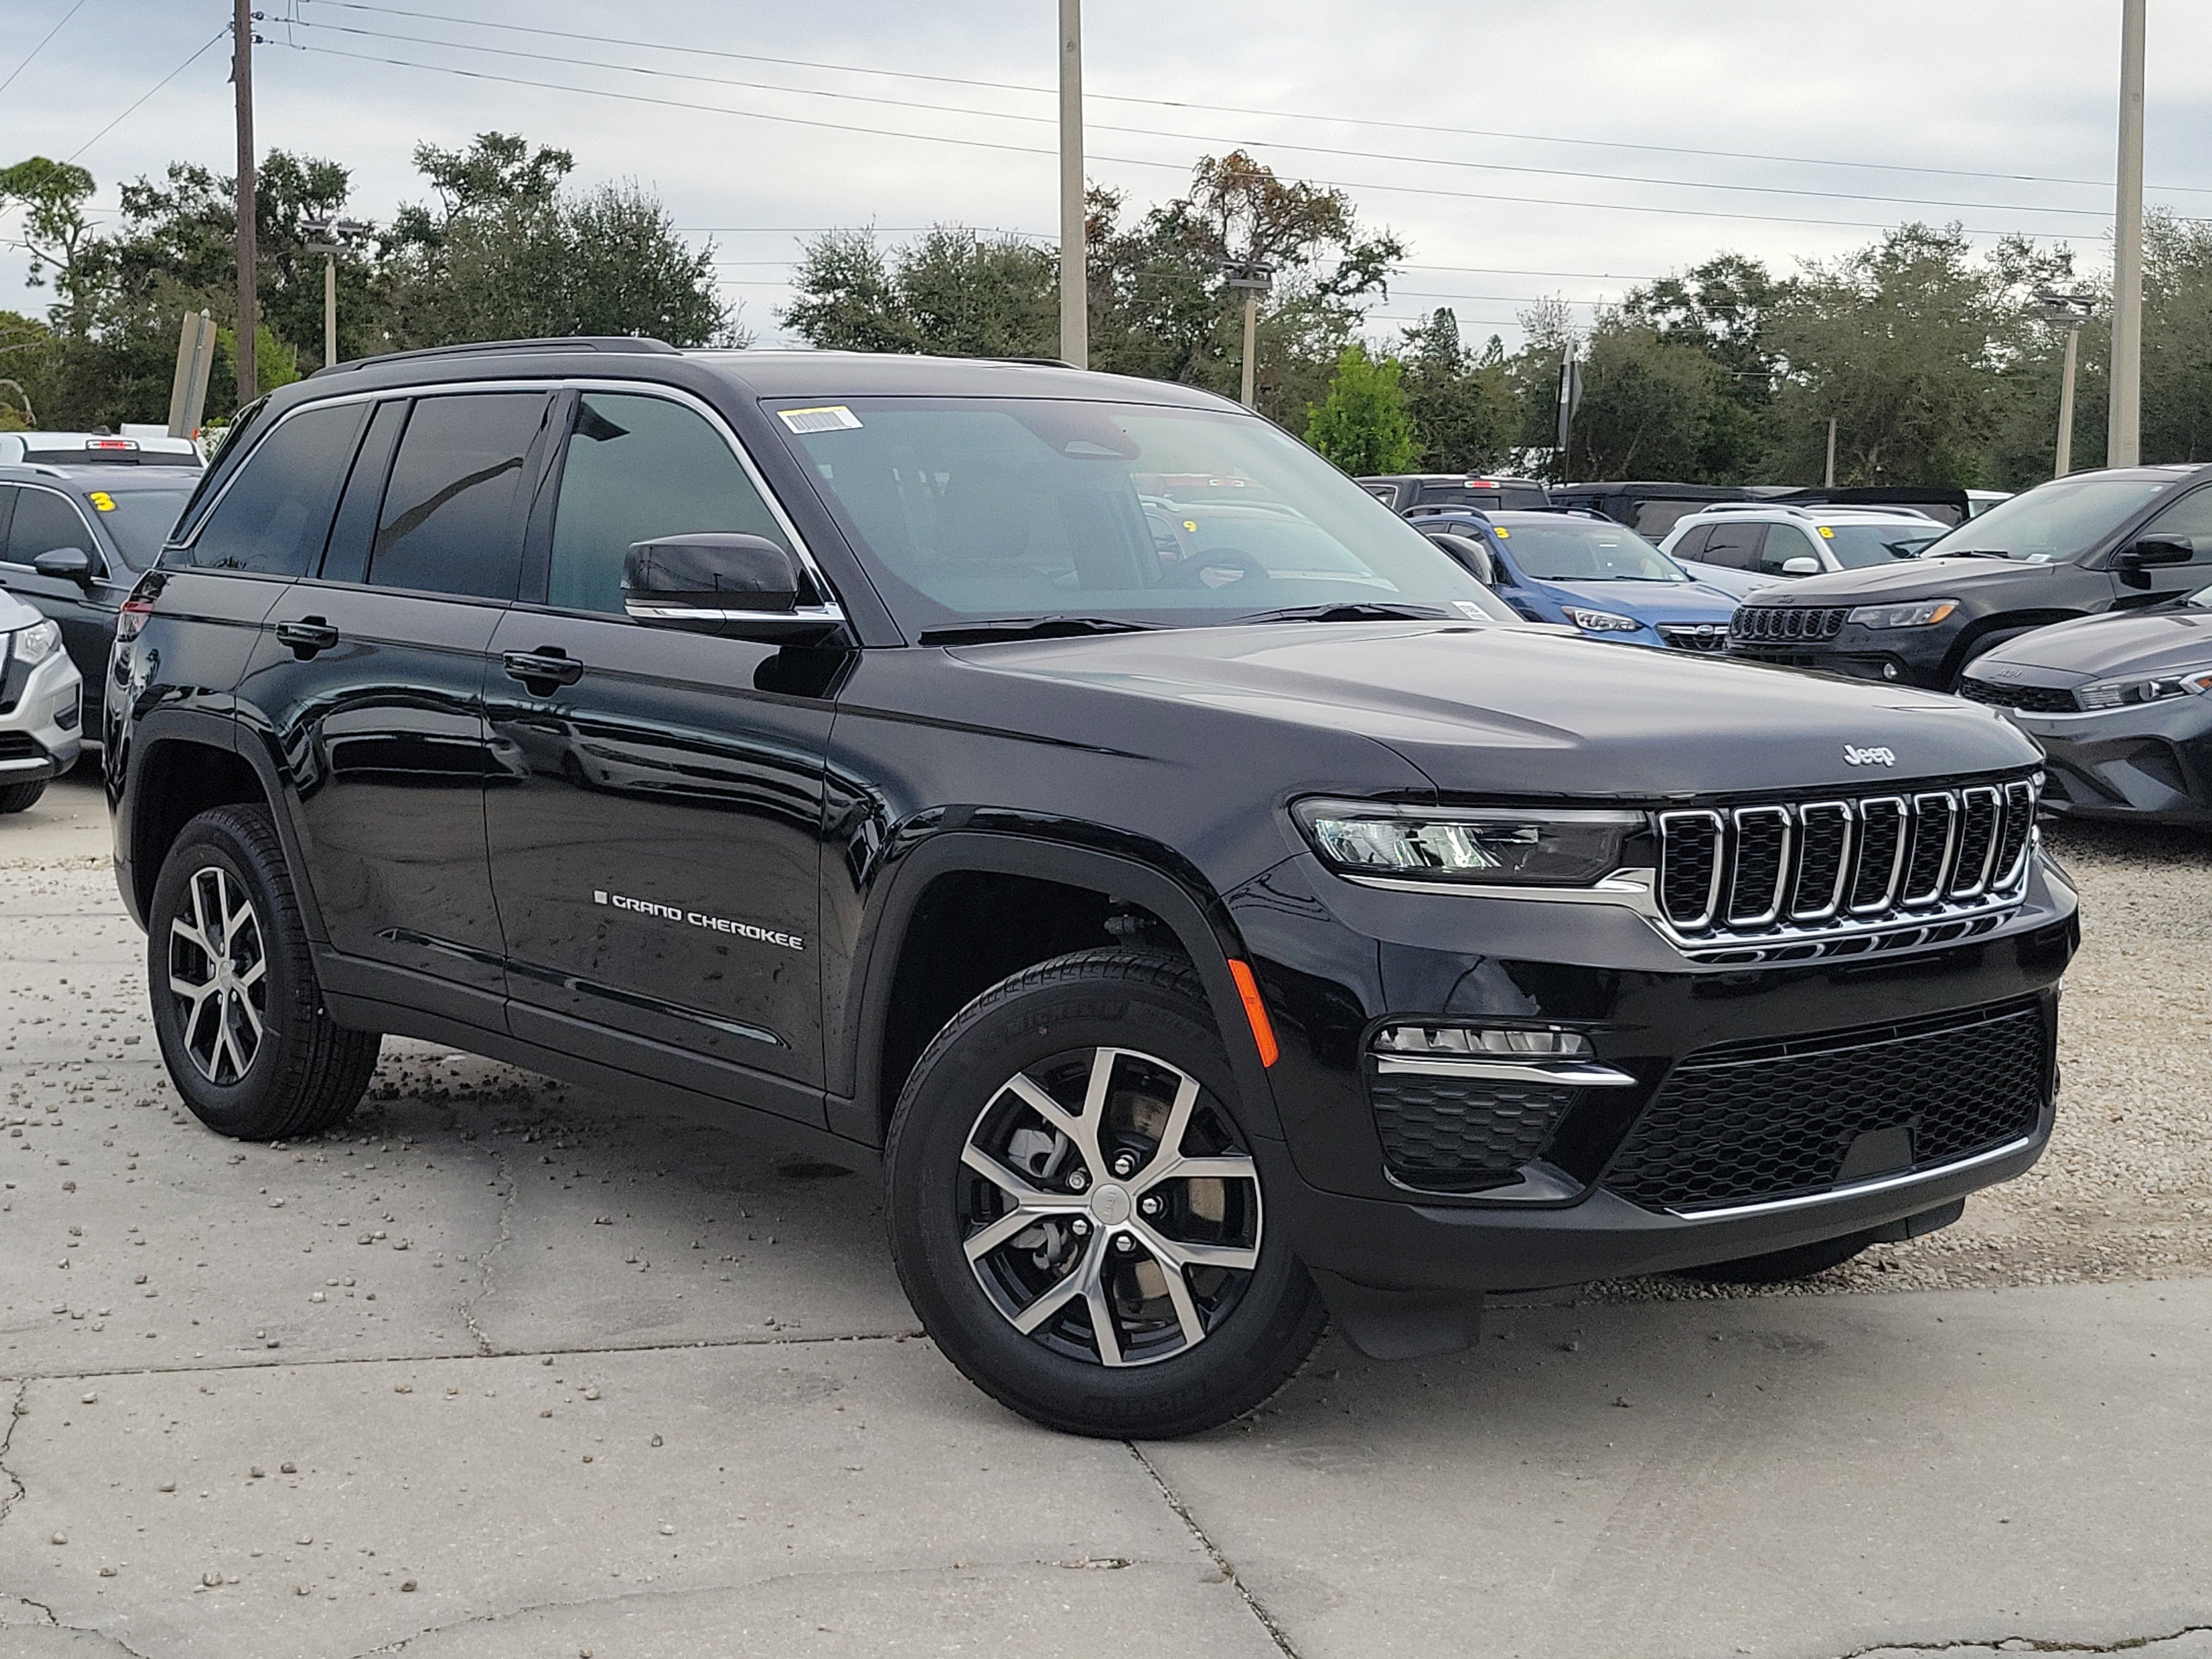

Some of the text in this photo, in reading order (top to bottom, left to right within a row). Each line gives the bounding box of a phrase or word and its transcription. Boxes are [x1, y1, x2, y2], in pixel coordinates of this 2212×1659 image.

[90, 492, 115, 511] 3
[1493, 527, 1509, 538] 3
[1843, 744, 1895, 767] Jeep
[612, 894, 804, 951] GRAND CHEROKEE
